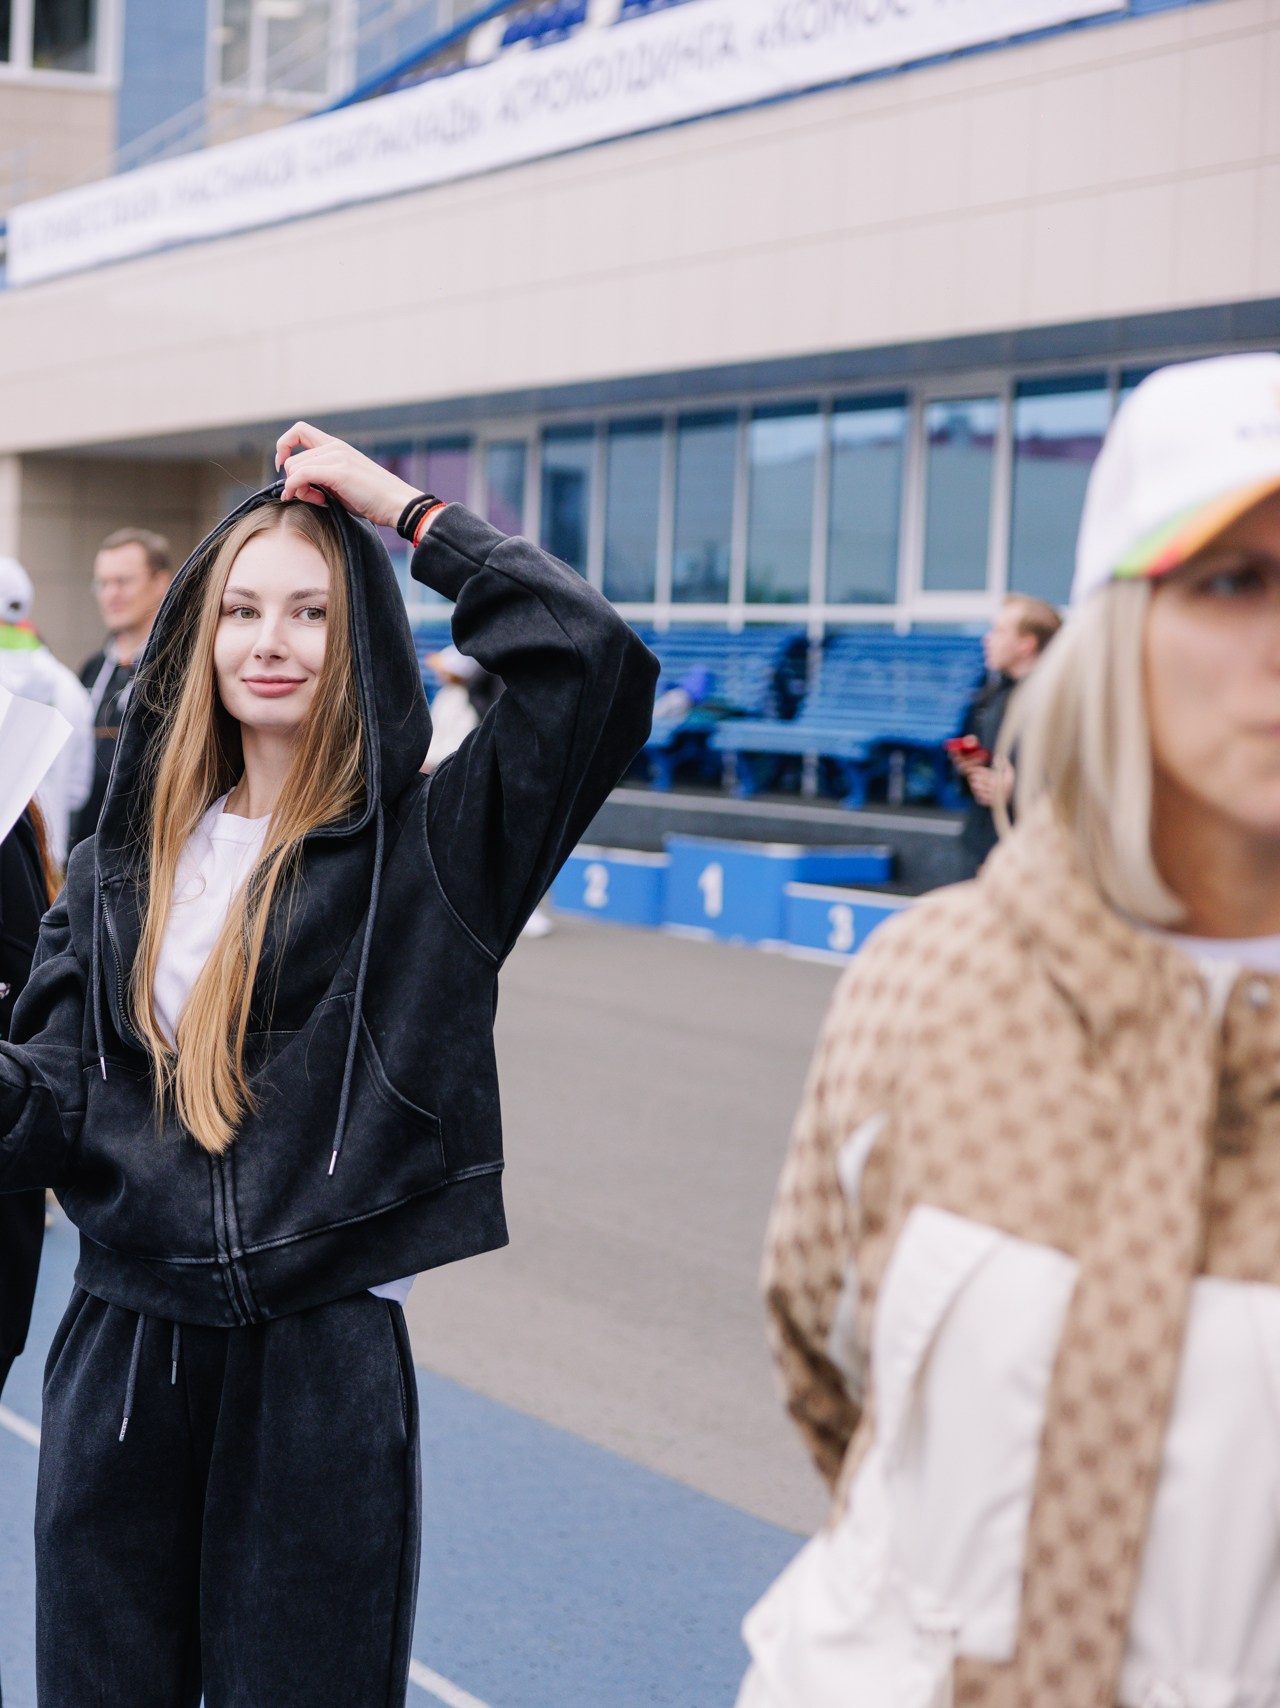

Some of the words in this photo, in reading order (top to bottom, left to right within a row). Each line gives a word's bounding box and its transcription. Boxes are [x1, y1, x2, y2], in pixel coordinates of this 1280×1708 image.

[583, 863, 609, 908] 2
[698, 862, 724, 918] 1
[827, 904, 855, 951] 3
